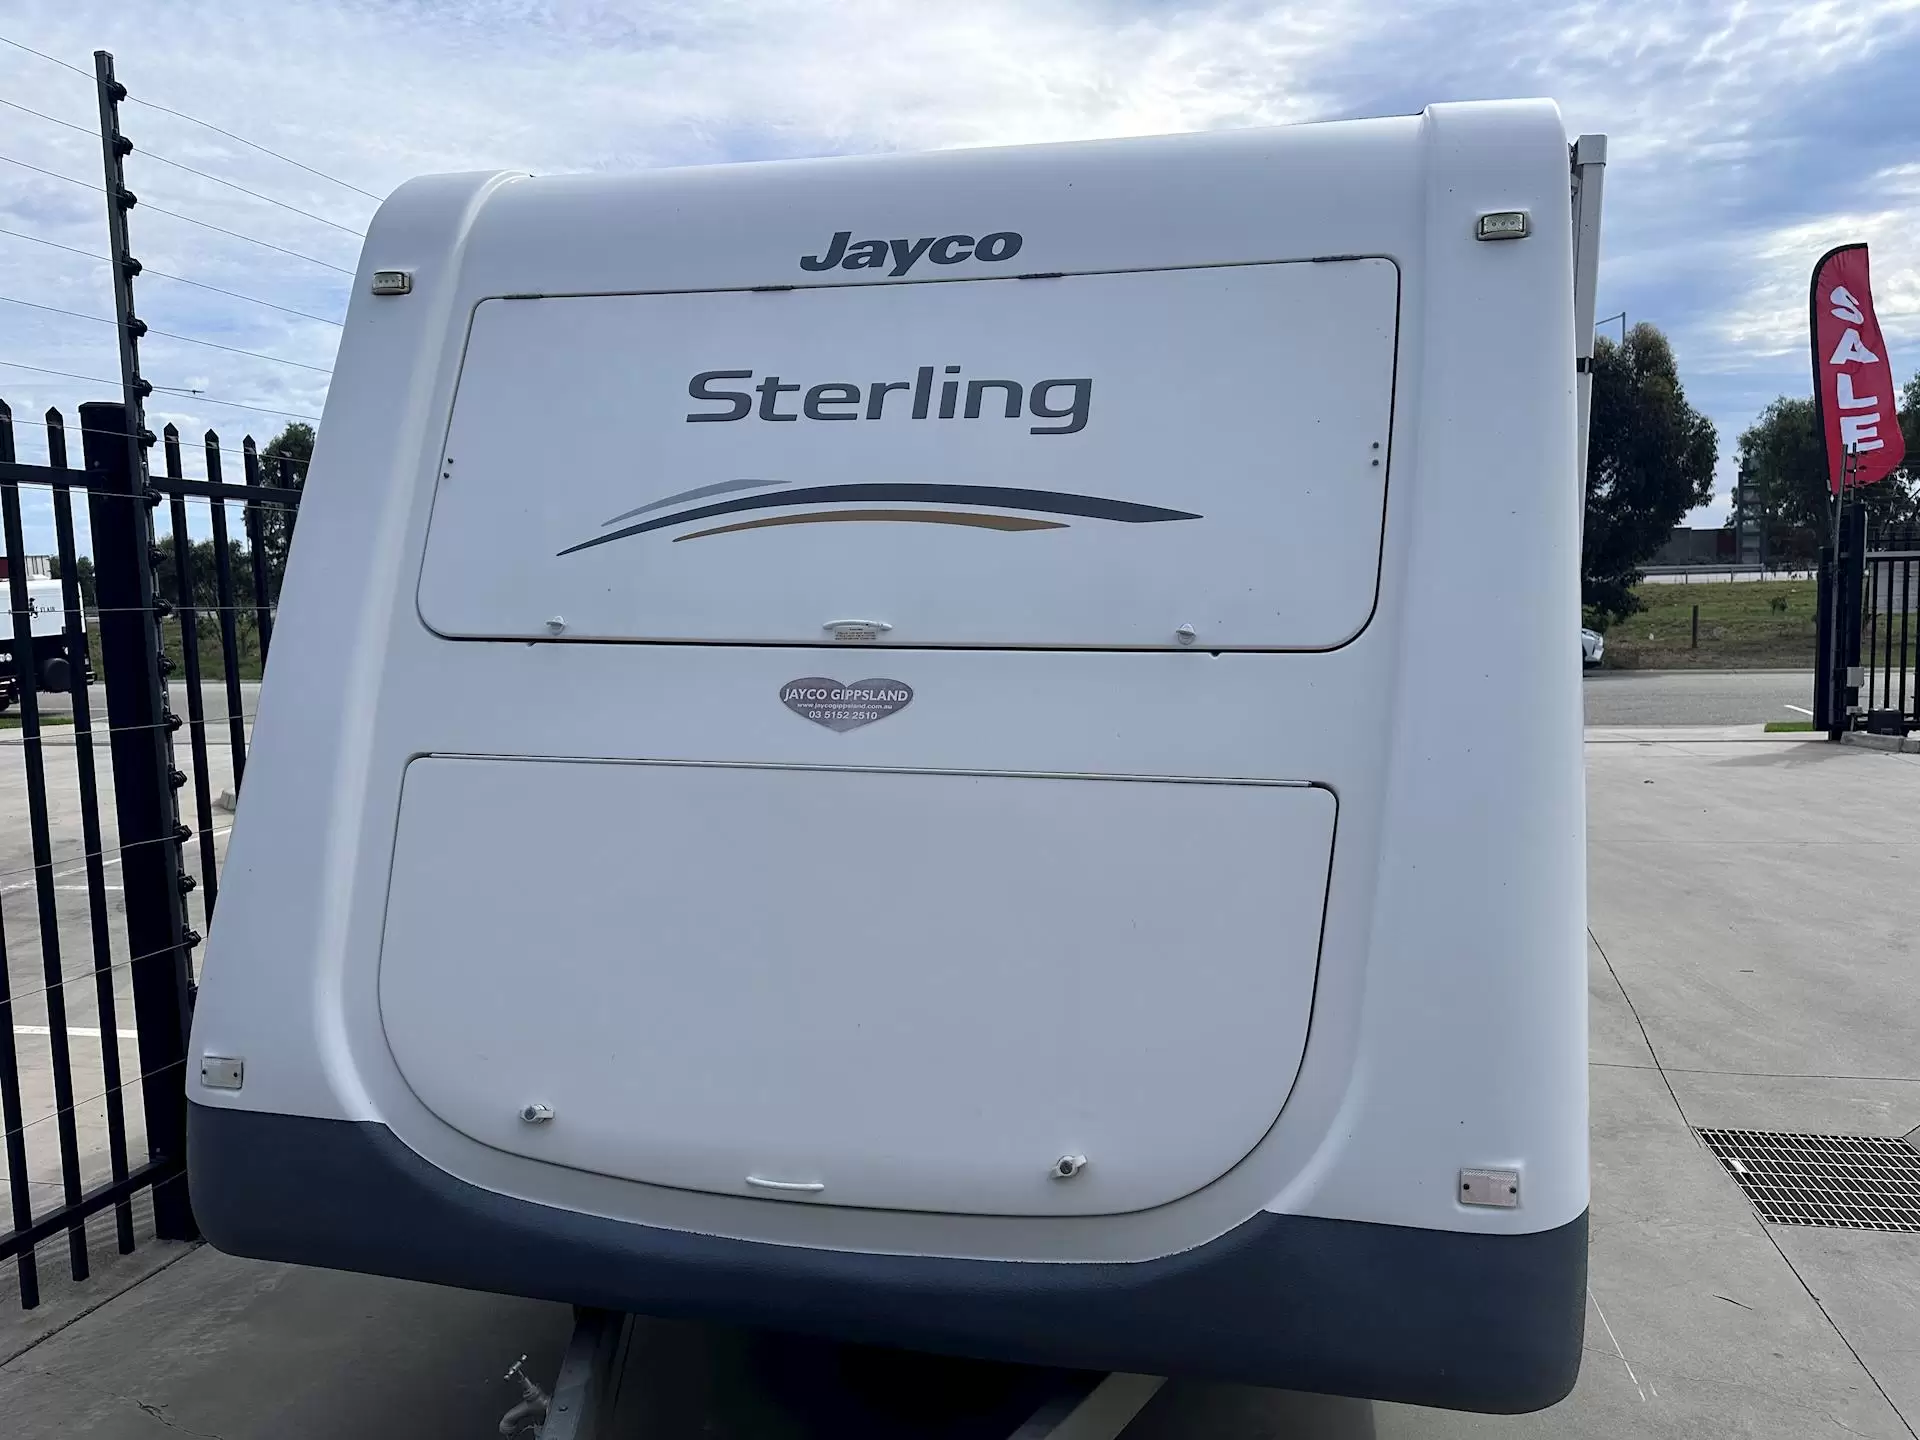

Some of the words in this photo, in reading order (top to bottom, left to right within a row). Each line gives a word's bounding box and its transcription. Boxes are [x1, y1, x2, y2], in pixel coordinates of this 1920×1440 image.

[799, 231, 1023, 277] Jayco
[1829, 285, 1884, 453] SALE
[686, 365, 1093, 435] Sterling
[783, 688, 827, 702] JAYCO
[830, 689, 908, 702] GIPPSLAND
[808, 710, 822, 719] 03
[824, 710, 850, 719] 5152
[852, 711, 878, 720] 2510
